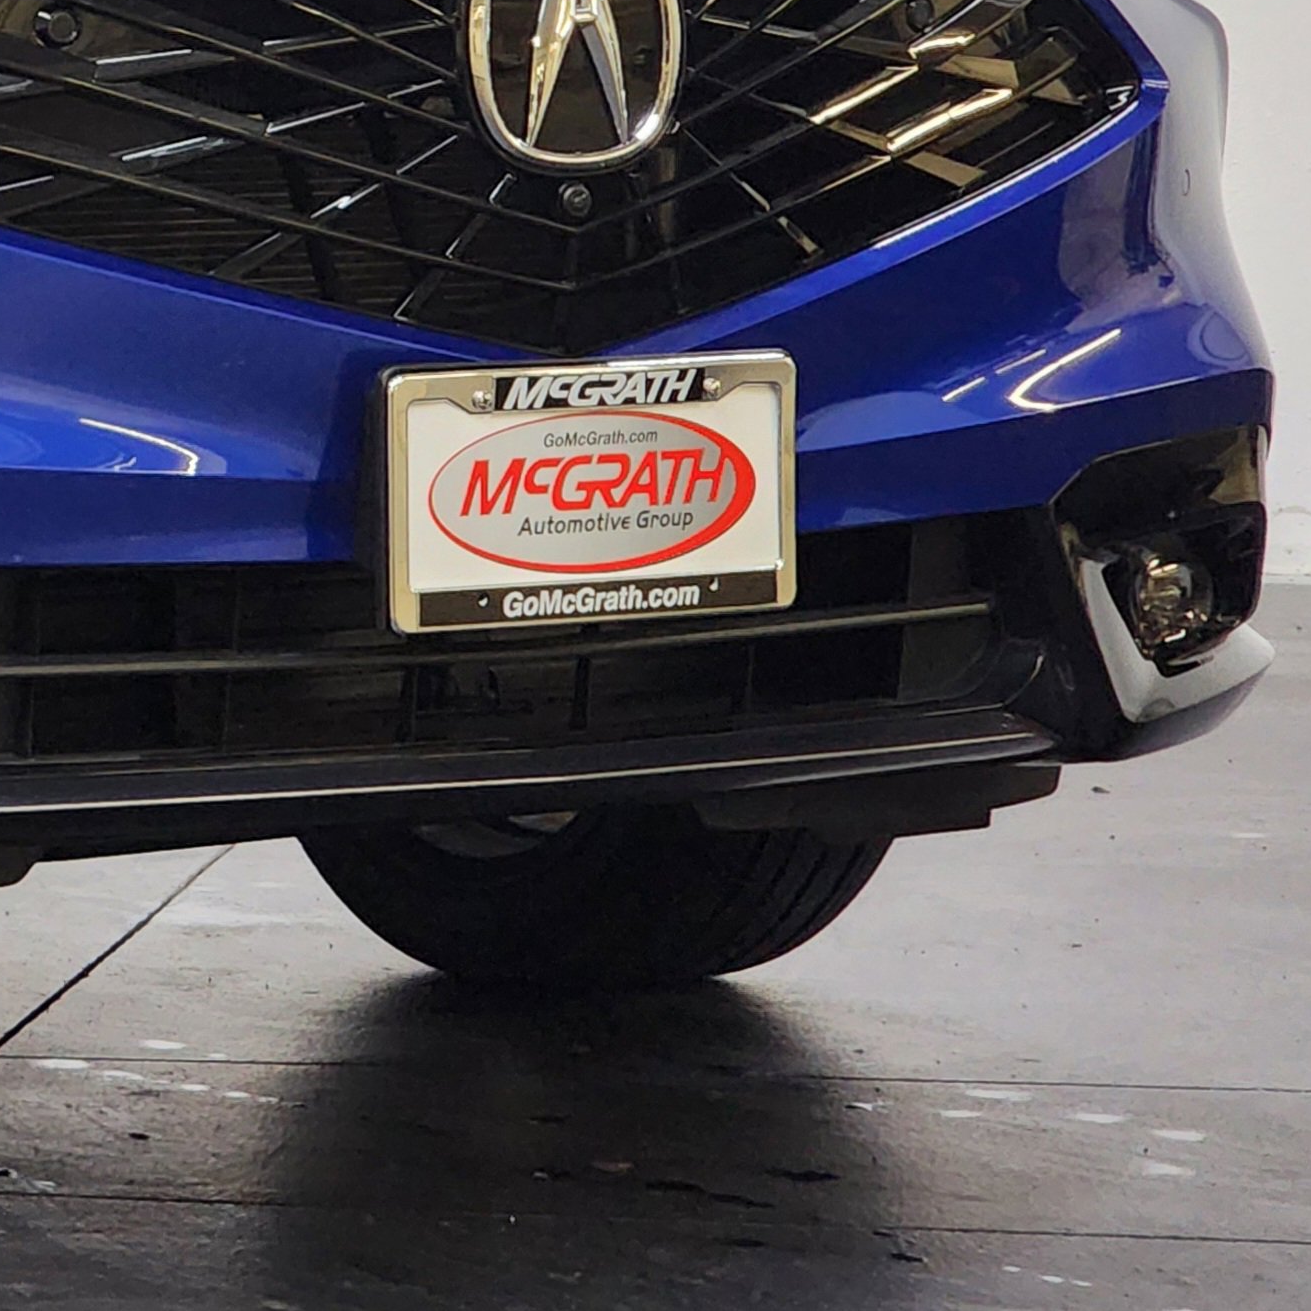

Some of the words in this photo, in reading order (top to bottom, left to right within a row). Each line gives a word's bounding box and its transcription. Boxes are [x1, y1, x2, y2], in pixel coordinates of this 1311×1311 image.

[543, 428, 659, 448] GoMcGrath.com
[517, 513, 631, 537] Automotive
[636, 510, 694, 536] Group
[502, 582, 700, 619] GoMcGrath.com
